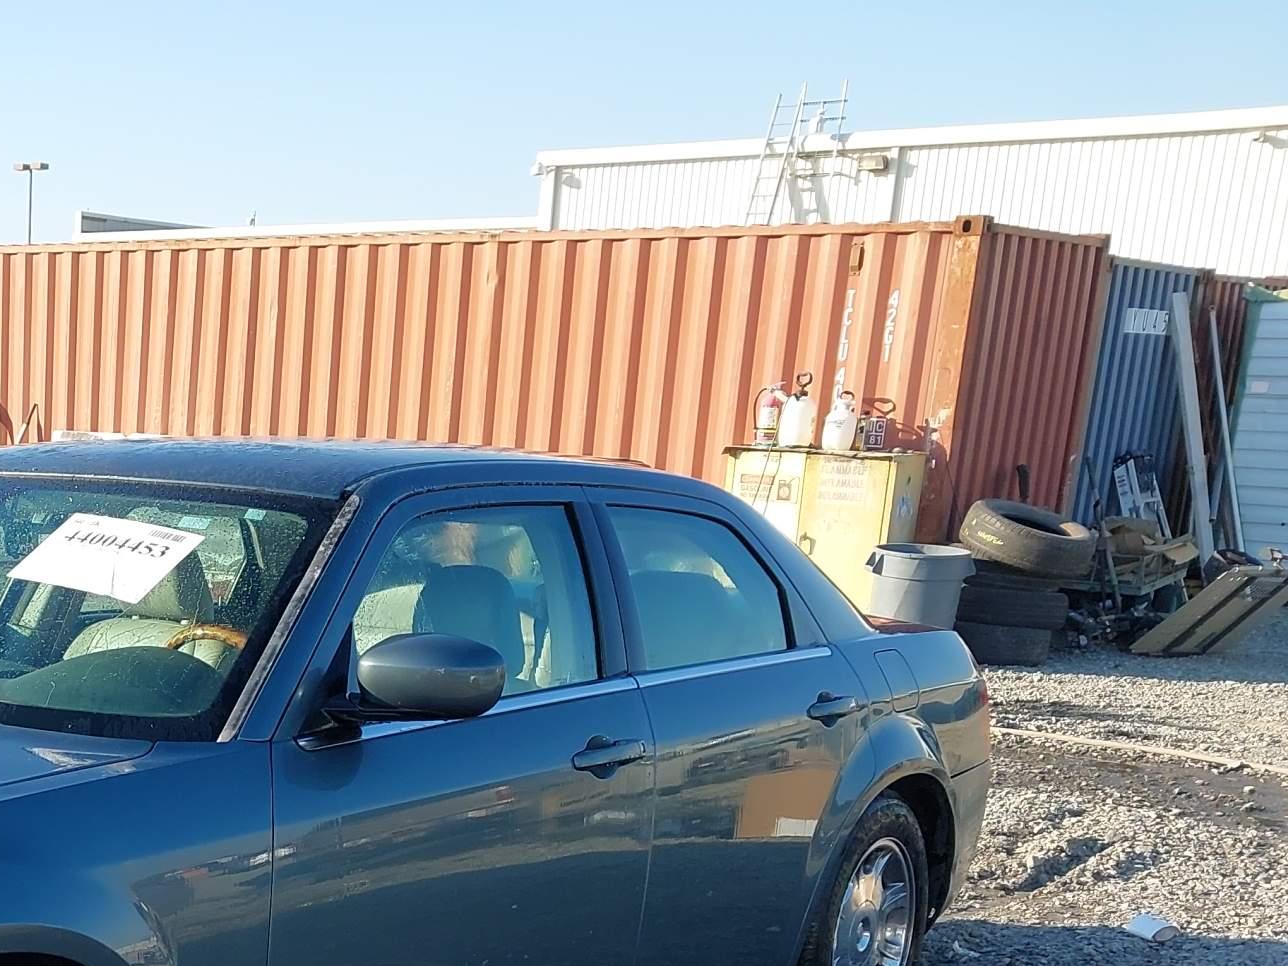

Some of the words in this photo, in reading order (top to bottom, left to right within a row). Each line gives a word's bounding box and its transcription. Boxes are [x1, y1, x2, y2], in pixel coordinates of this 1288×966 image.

[839, 288, 857, 361] TCLU
[882, 288, 901, 363] 42G1
[64, 529, 171, 558] 44004453
